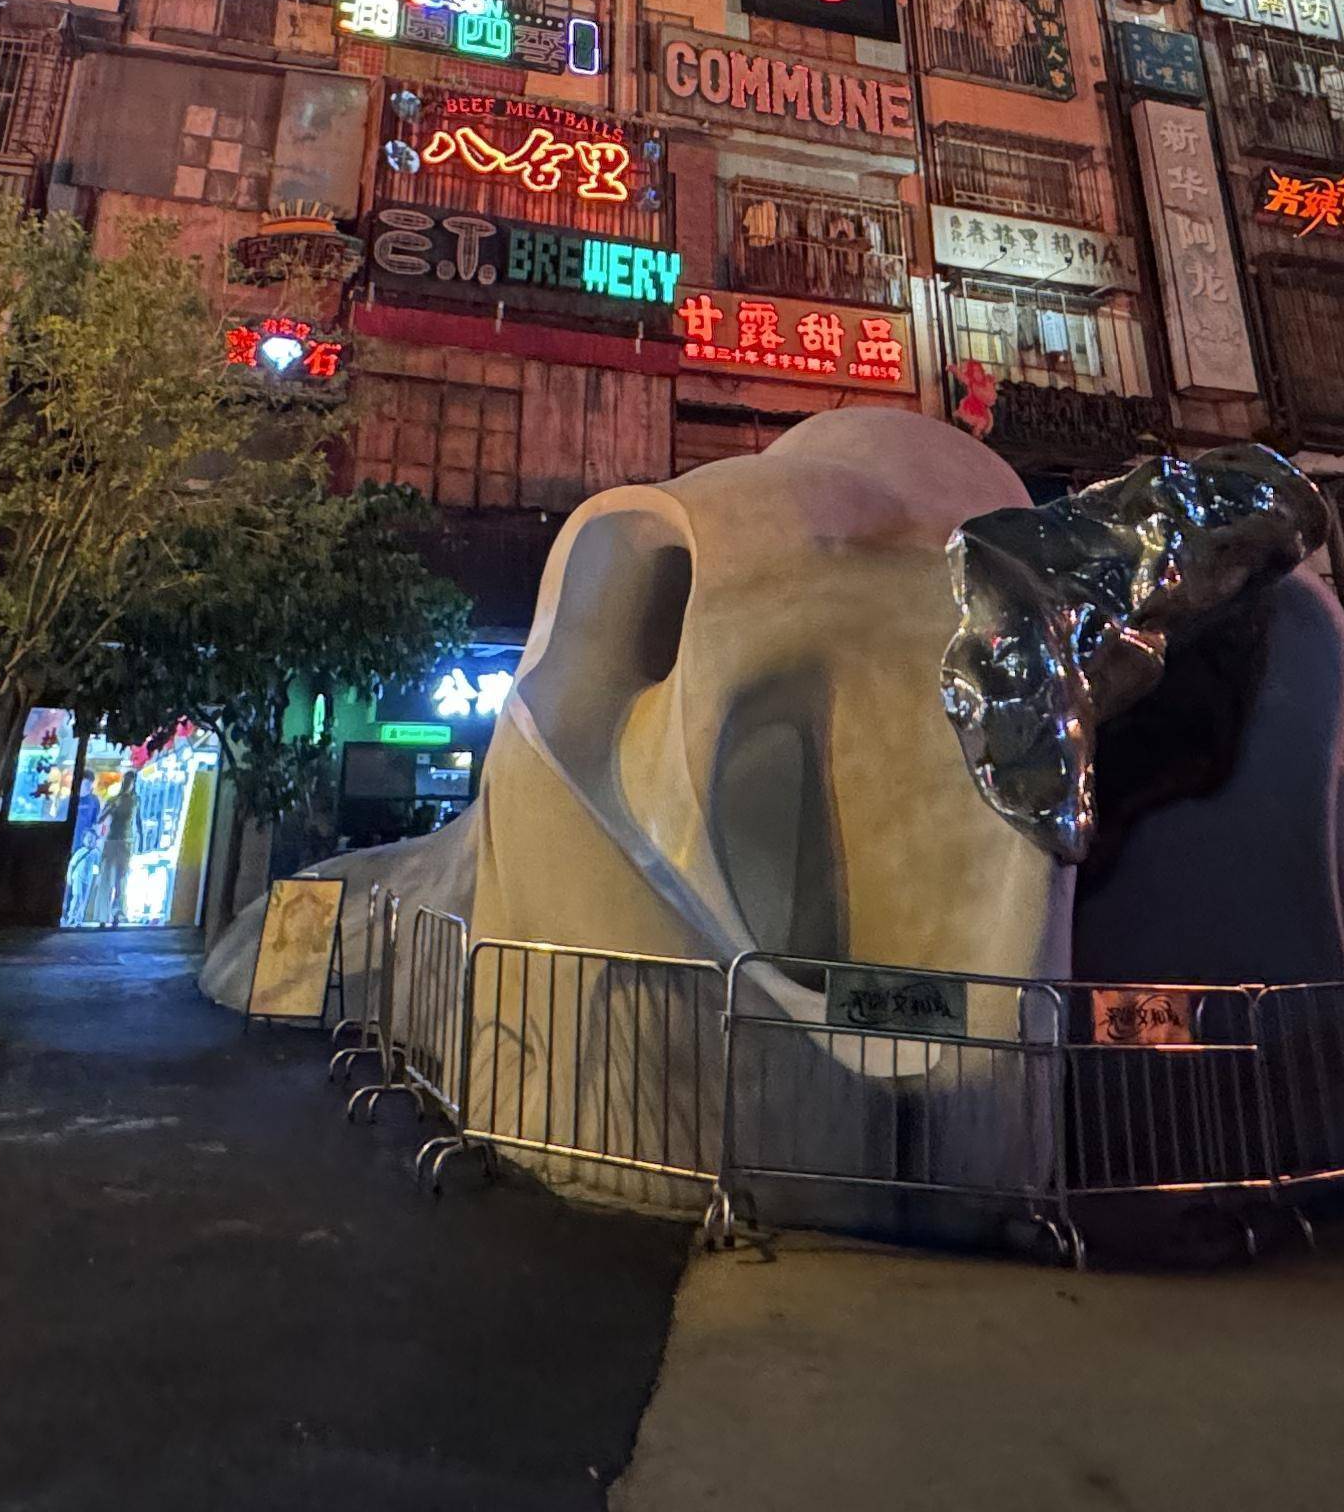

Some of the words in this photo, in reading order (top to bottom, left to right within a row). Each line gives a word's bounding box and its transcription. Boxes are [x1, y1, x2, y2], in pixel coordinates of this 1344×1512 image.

[446, 97, 496, 114] BEEF
[505, 100, 624, 143] MEATBALLS
[665, 40, 916, 138] COMMUNE
[508, 226, 682, 304] BREWERY
[677, 294, 903, 363] 甘露甜品
